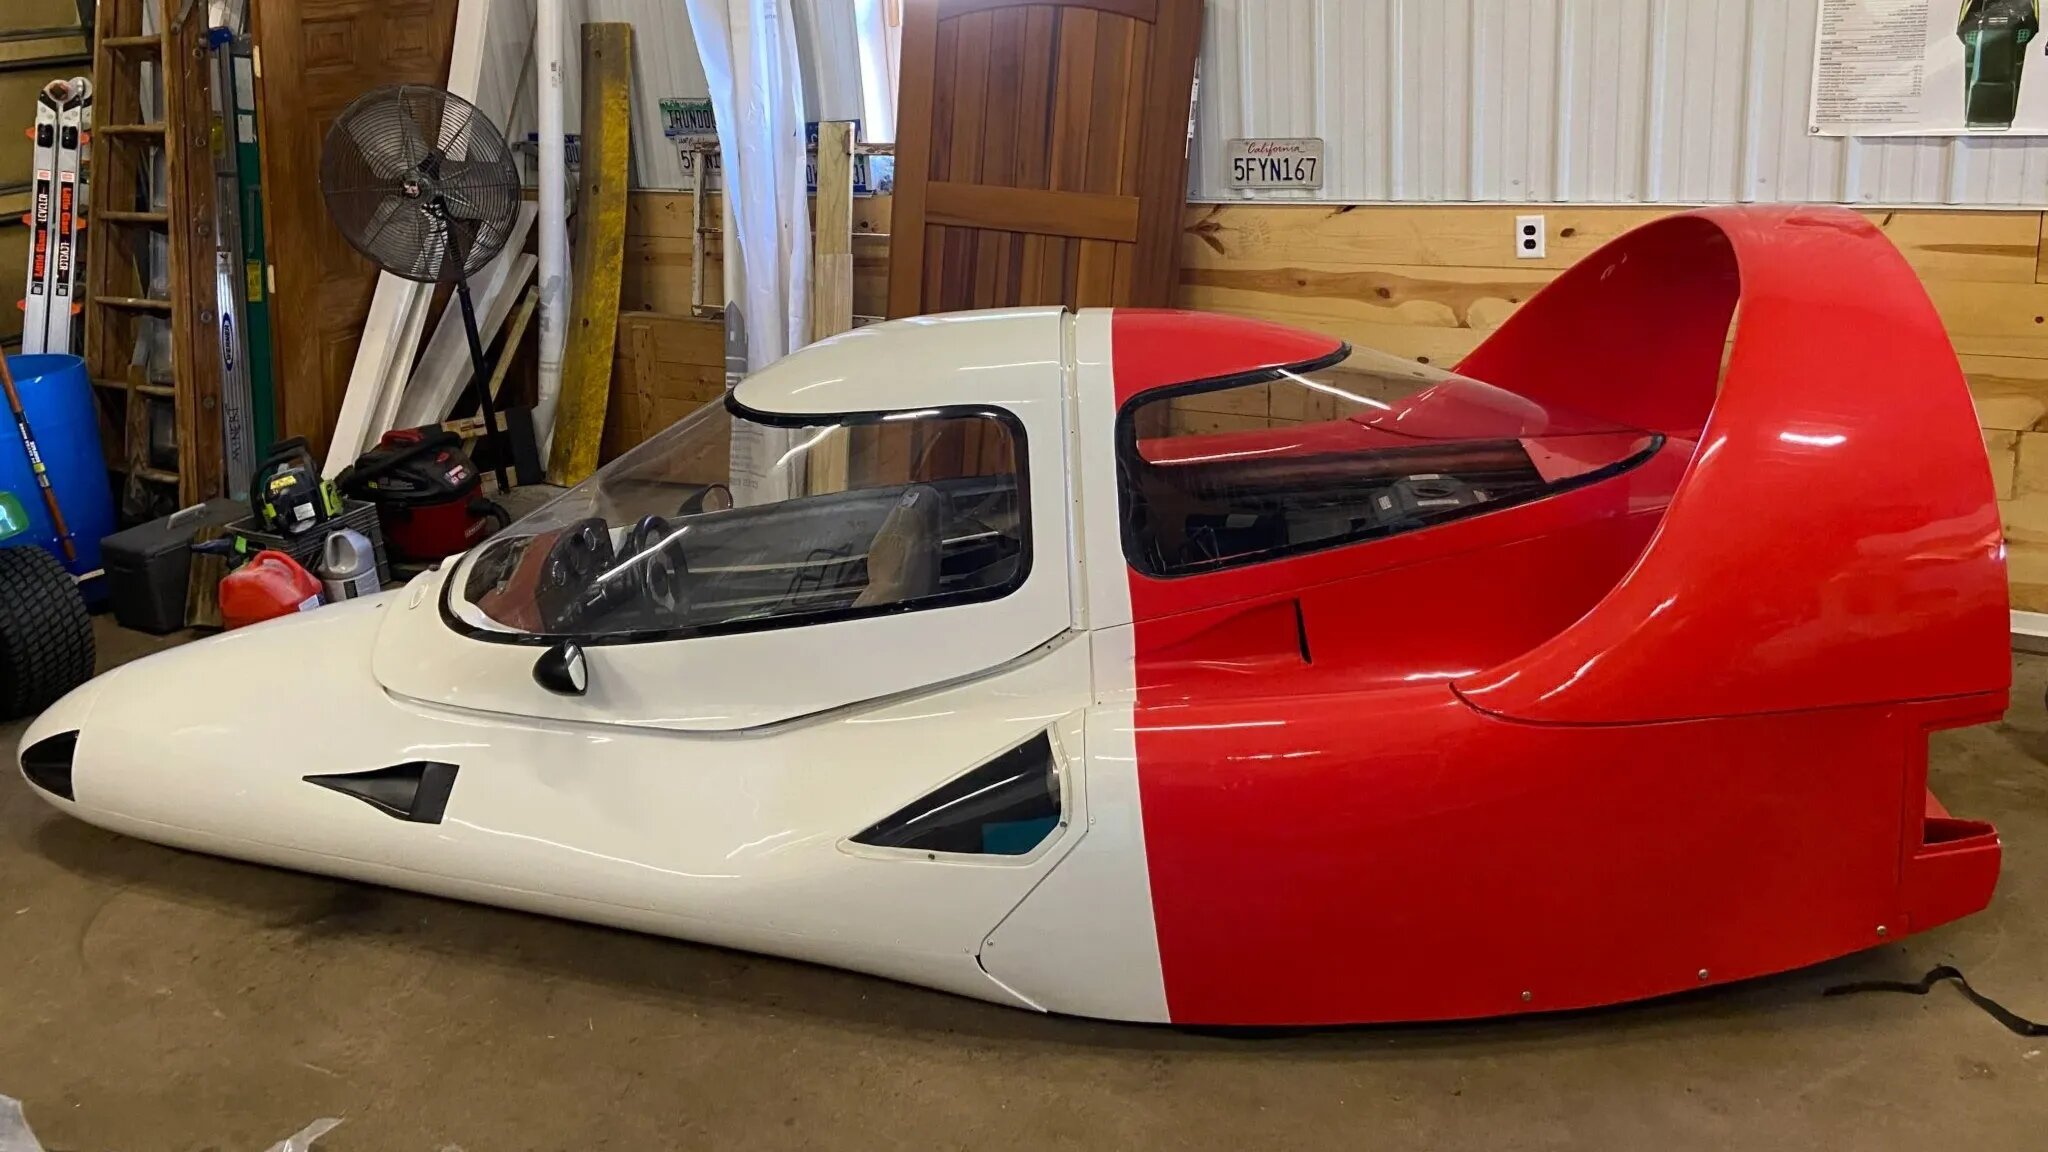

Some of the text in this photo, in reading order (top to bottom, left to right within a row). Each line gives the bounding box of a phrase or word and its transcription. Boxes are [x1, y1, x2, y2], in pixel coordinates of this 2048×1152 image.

[1247, 142, 1306, 156] California
[1233, 157, 1317, 182] 5FYN167
[37, 193, 49, 222] LEVELER
[59, 242, 70, 271] LEVELER
